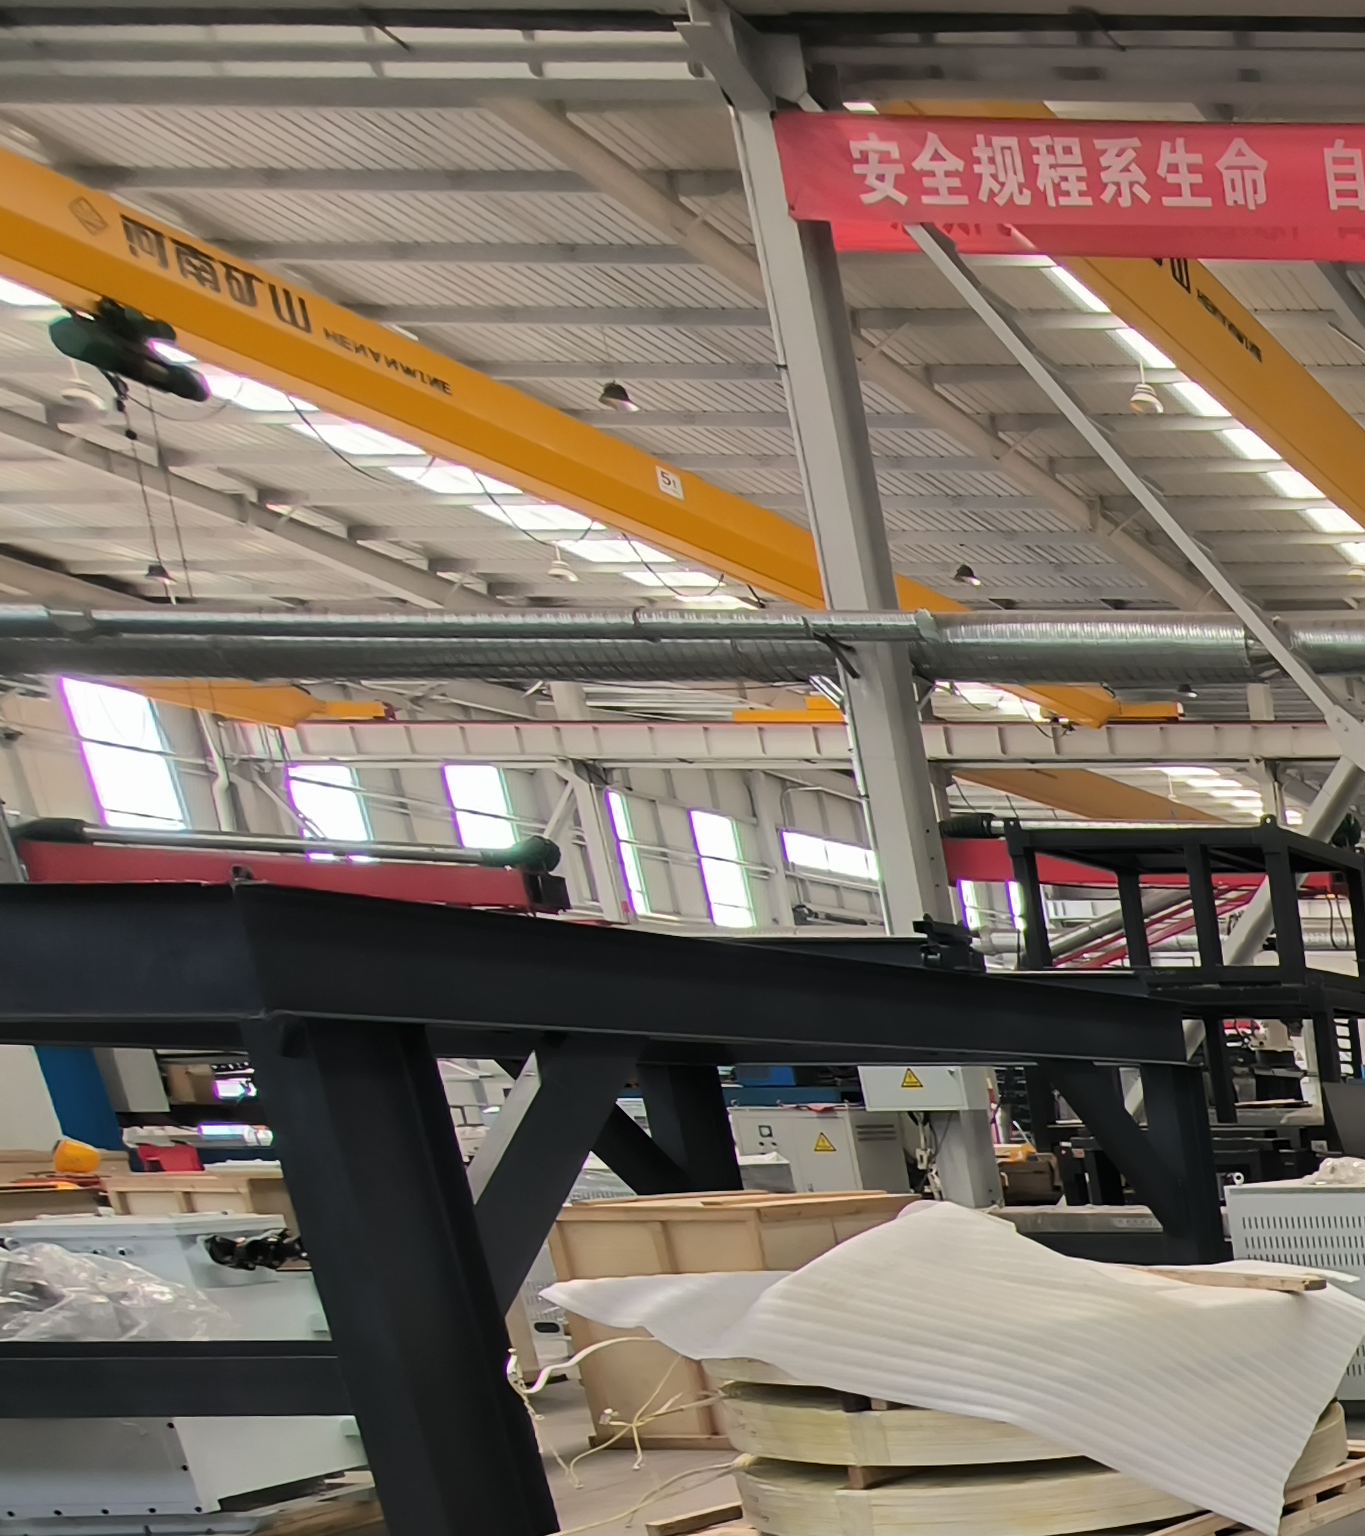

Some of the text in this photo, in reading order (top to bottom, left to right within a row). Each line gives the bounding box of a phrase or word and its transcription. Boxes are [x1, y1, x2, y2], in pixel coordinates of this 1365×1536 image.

[849, 131, 1269, 211] 安全规程系生命
[119, 213, 312, 334] 河南矿山
